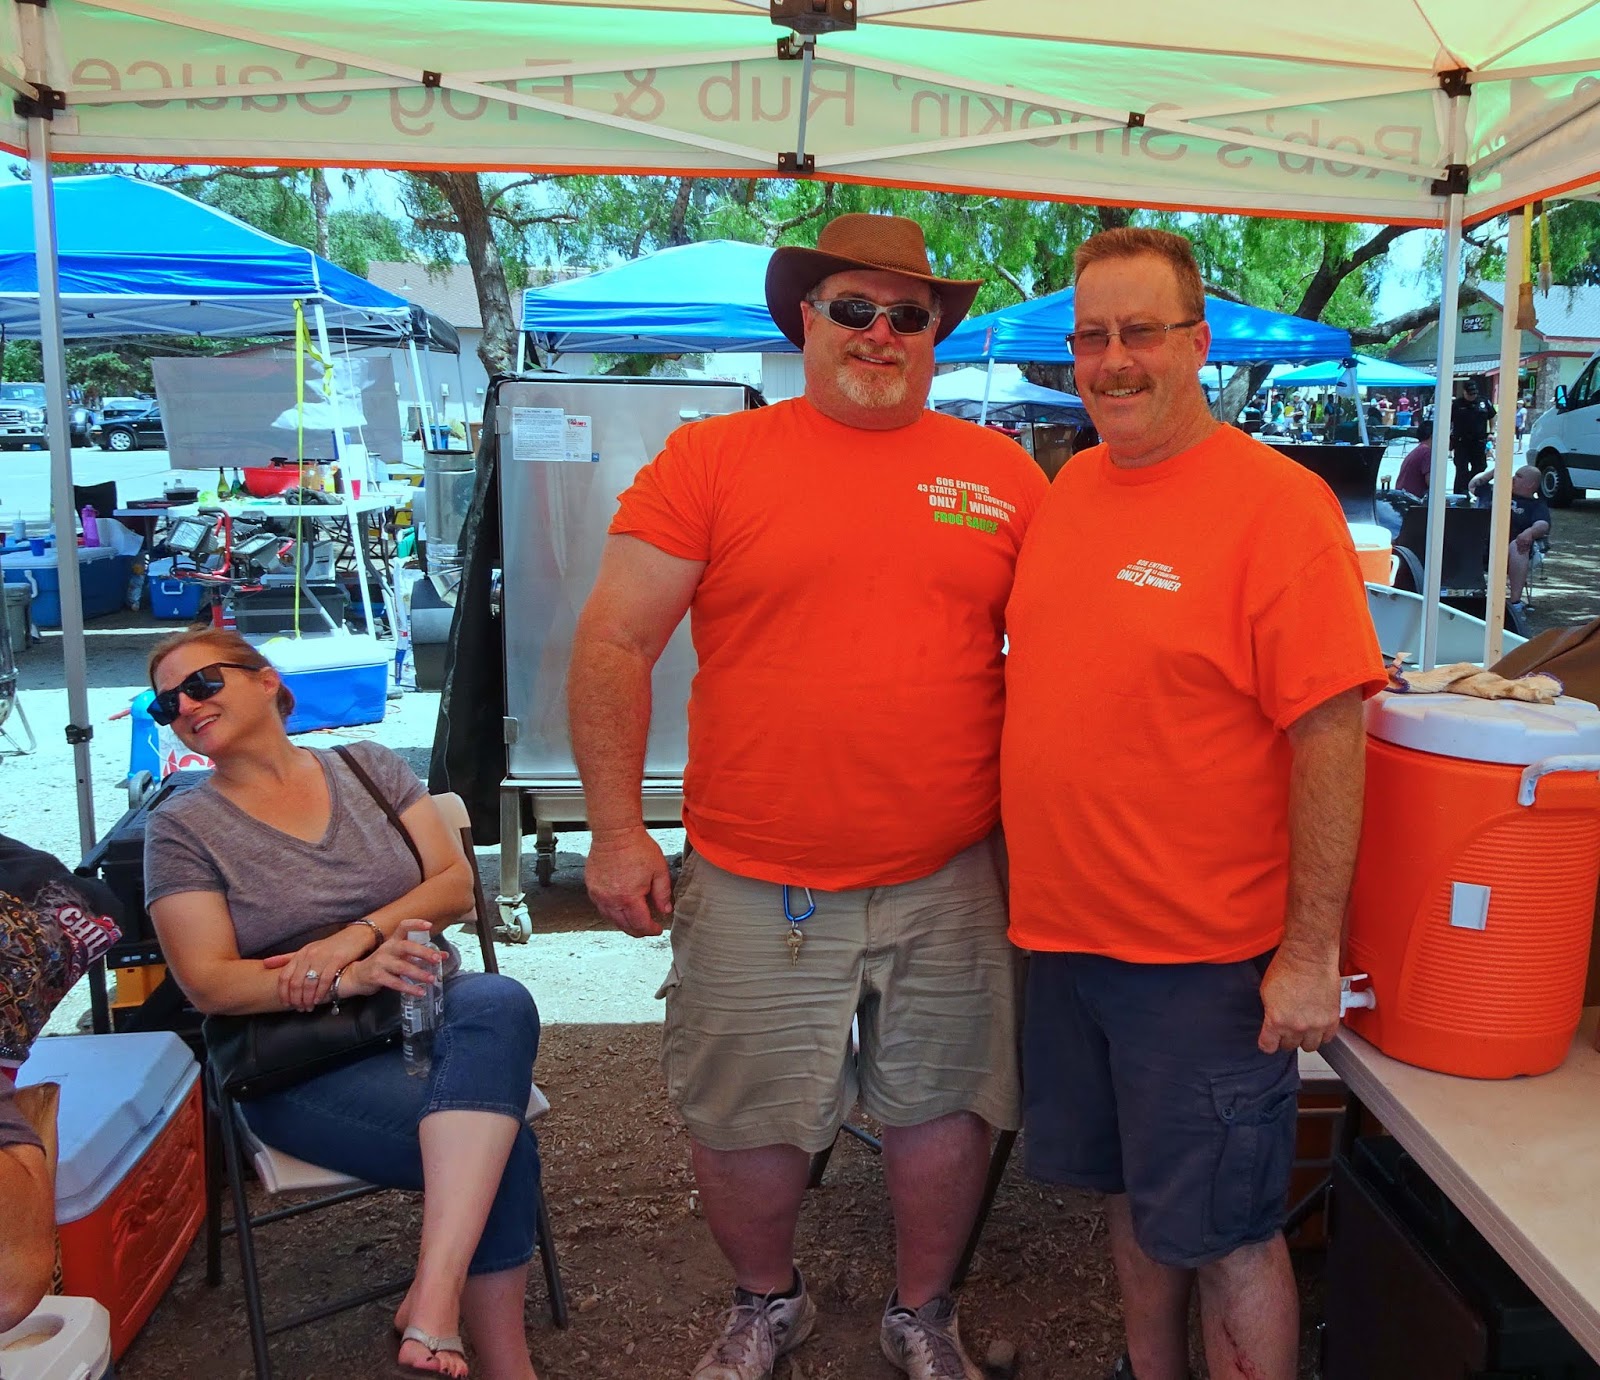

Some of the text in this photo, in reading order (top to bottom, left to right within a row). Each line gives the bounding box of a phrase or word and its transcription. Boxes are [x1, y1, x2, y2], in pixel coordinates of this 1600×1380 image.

[917, 484, 957, 496] 43 STATES
[936, 477, 990, 494] 606 ENTRIES
[928, 490, 1010, 522] ONLY 1 WINNER
[983, 494, 1016, 513] COUNTRIES
[934, 511, 999, 534] FROG SAUCE
[1116, 569, 1142, 582] ONLY
[1134, 568, 1153, 586] 1
[1145, 575, 1182, 592] WINNER
